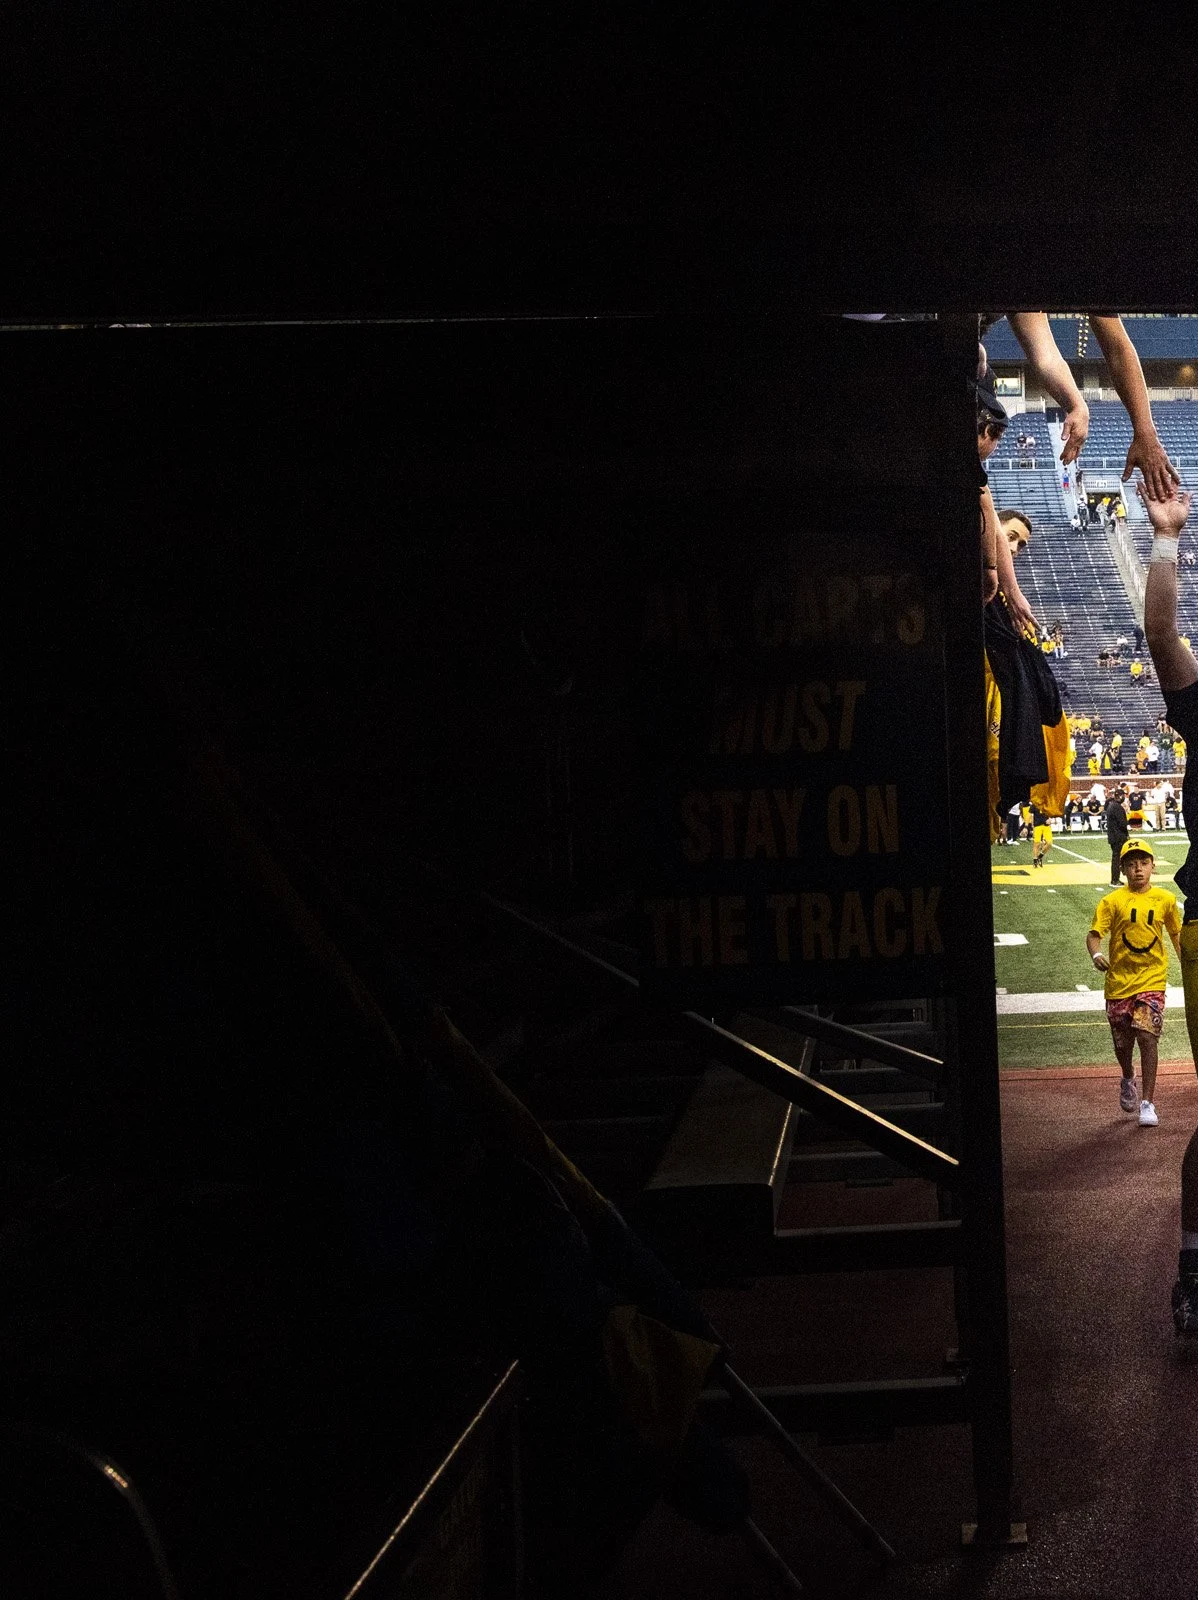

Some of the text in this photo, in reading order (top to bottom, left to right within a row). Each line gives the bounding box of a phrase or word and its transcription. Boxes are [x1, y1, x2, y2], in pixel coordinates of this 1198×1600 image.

[642, 580, 734, 651] ALL
[753, 572, 925, 647] CARTS
[708, 679, 867, 756] MUST
[679, 783, 900, 863] STAY ON
[642, 886, 945, 968] THE TRACK
